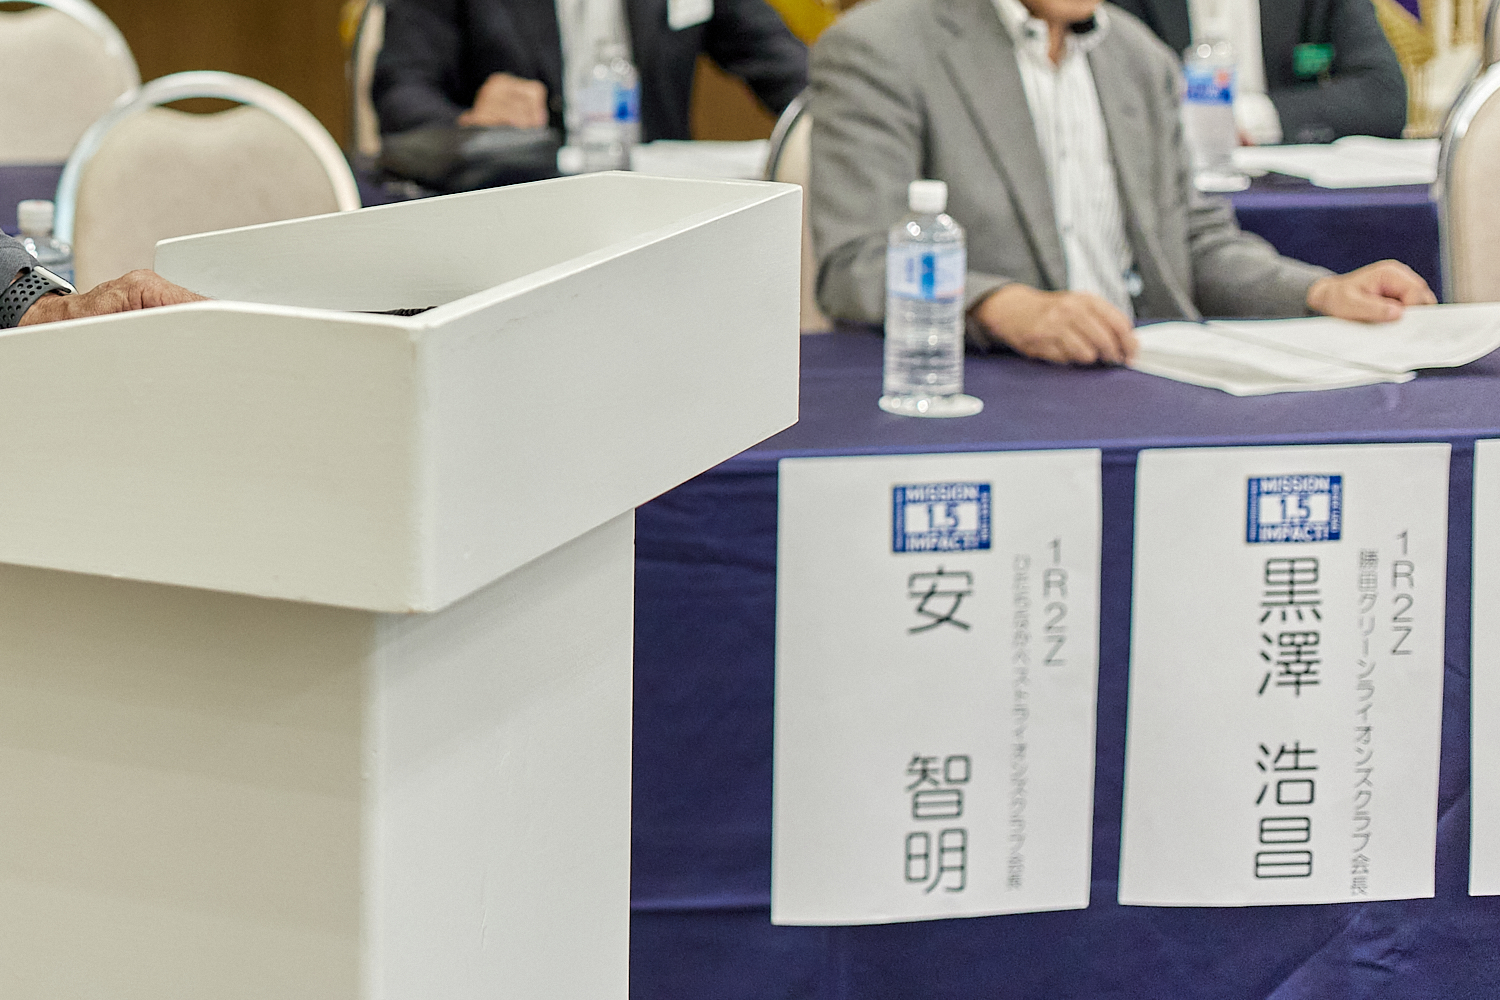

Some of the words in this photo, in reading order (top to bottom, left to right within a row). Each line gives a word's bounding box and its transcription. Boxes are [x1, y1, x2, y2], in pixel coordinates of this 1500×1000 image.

[905, 485, 979, 502] MISSION
[1259, 477, 1331, 493] MISSION
[907, 564, 974, 635] 安
[1042, 537, 1069, 667] 1R2Z
[1258, 556, 1323, 696] 黒澤
[1391, 529, 1416, 656] 1R2Z
[904, 752, 972, 895] 智明
[1254, 740, 1320, 879] 浩昌
